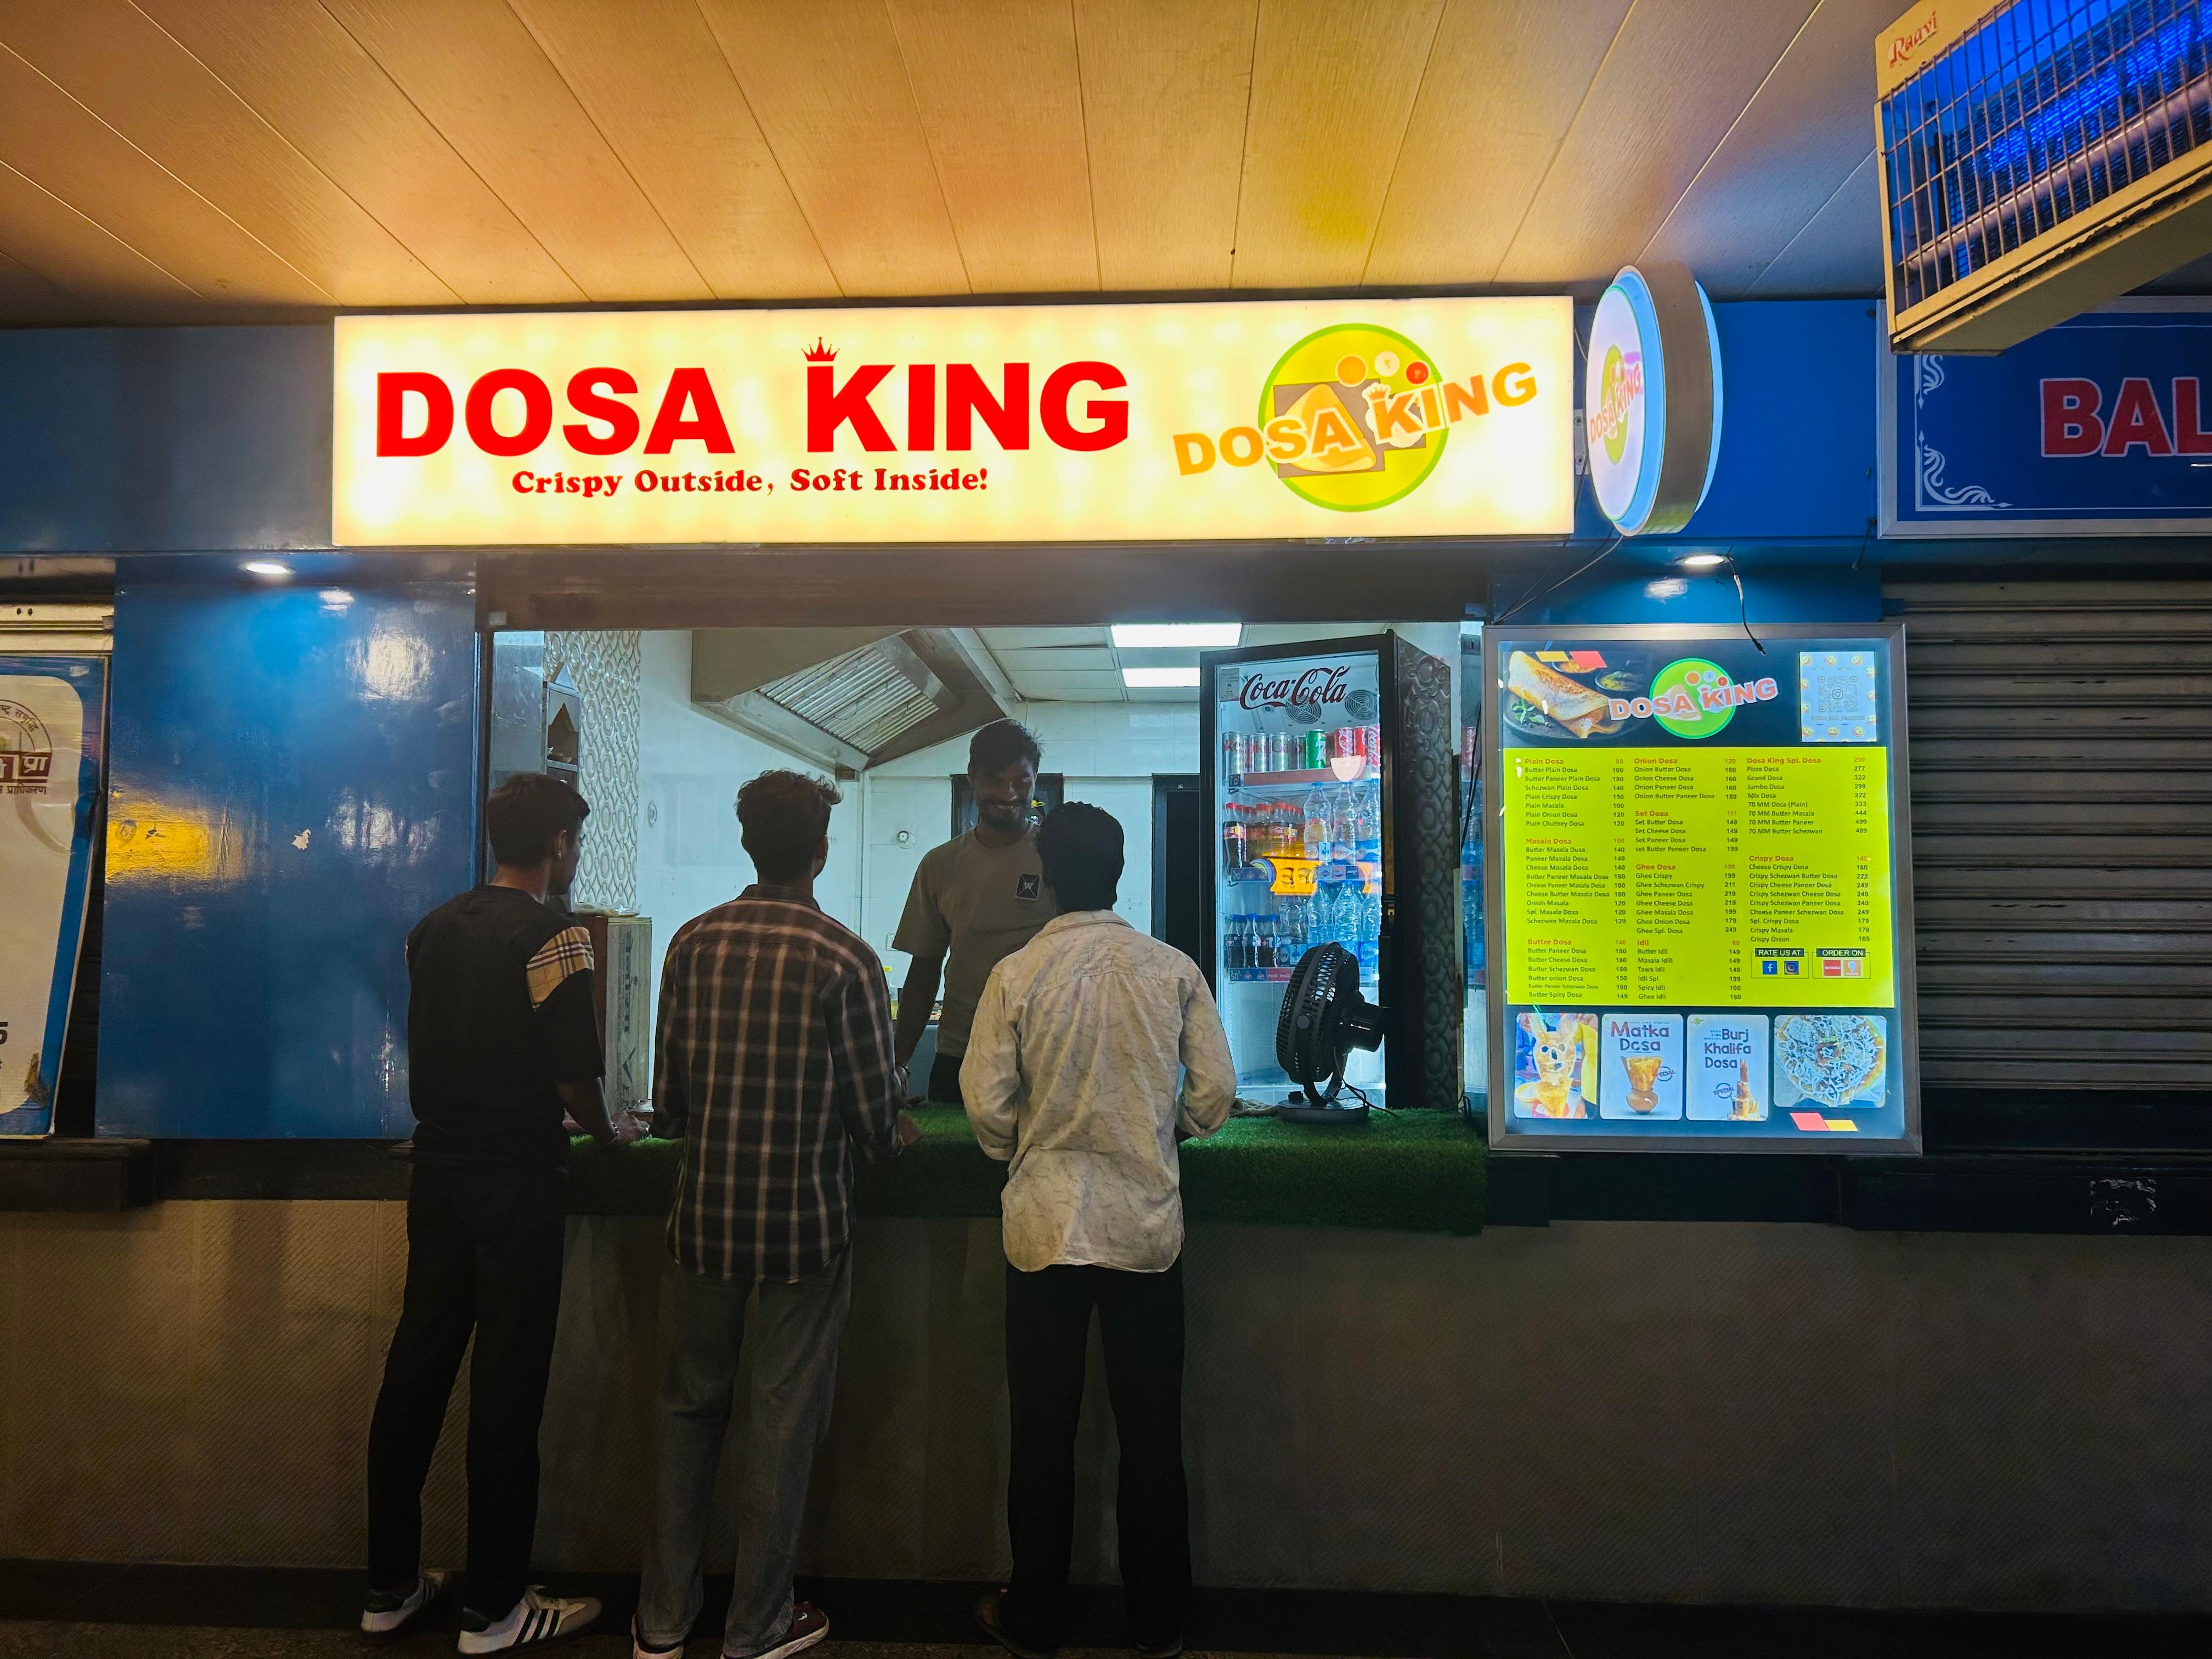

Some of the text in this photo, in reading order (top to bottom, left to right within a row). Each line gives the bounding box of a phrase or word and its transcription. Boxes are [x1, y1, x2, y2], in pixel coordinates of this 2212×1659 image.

[377, 361, 1129, 457] DOSA KING
[1590, 364, 1640, 443] DOSA KING
[1173, 363, 1537, 476] DOSA KING
[512, 467, 988, 498] Crispy Outside, Soft Inside!
[1239, 665, 1351, 710] Coca-Cola
[1610, 679, 1776, 720] DOSA KING
[6, 783, 47, 795] प्राधिकरण
[1611, 1021, 1669, 1037] Matka
[1722, 1029, 1749, 1042] Burj
[1704, 1042, 1751, 1054] Khalifa
[1705, 1057, 1738, 1069] Dosa
